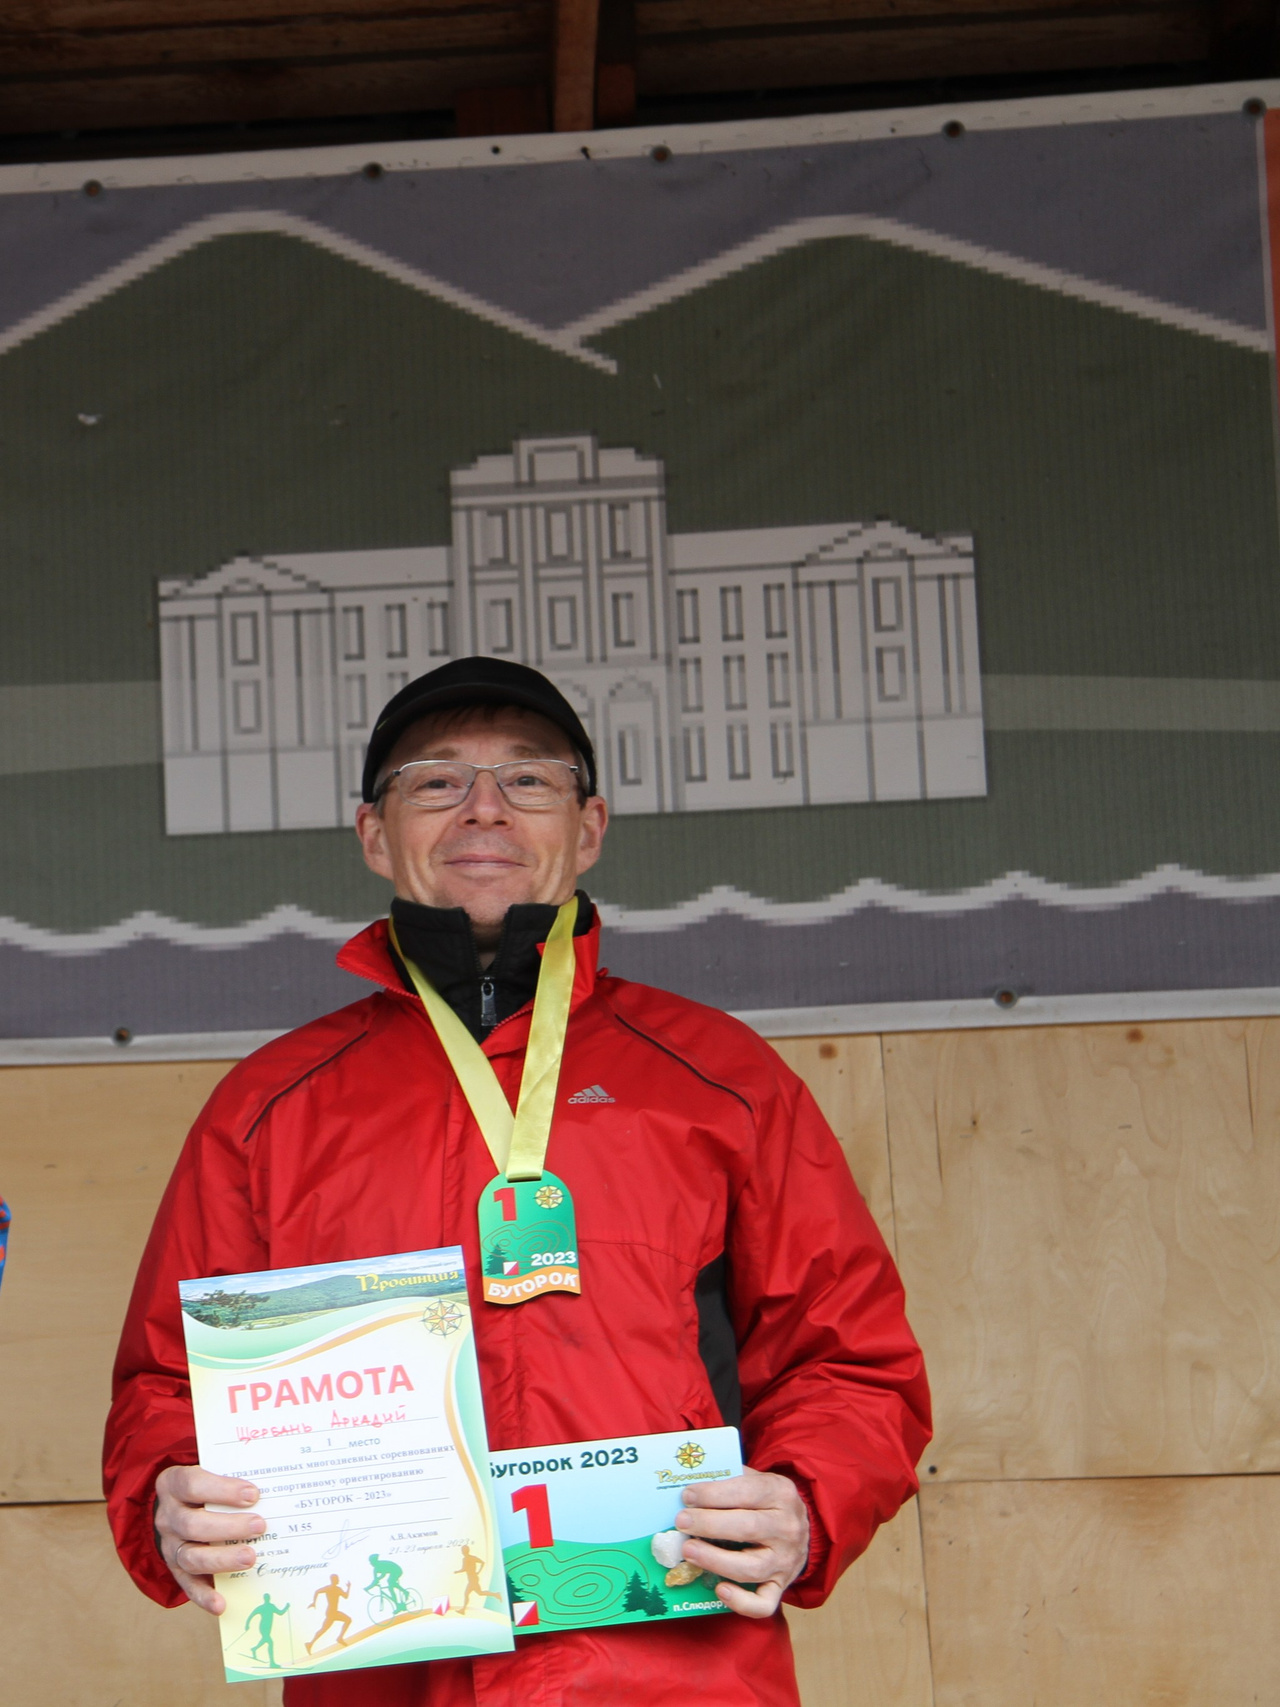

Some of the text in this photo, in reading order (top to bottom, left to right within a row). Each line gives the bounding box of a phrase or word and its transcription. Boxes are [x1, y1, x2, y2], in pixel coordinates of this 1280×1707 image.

[567, 1094, 616, 1104] adidas
[493, 1187, 517, 1222] 1
[530, 1251, 577, 1266] 2023
[487, 1271, 579, 1298] БУГОРОК
[226, 1364, 415, 1414] ГРАМОТА
[348, 1437, 381, 1448] место
[231, 1462, 304, 1478] традиционных
[306, 1453, 378, 1468] многодневных
[380, 1444, 455, 1460] соревнованиях
[580, 1446, 639, 1469] 2023
[272, 1478, 336, 1493] спортивному
[339, 1468, 424, 1486] ориентированию
[294, 1494, 353, 1509] «БУГОРОК
[301, 1522, 312, 1531] 55
[510, 1483, 555, 1549] 1
